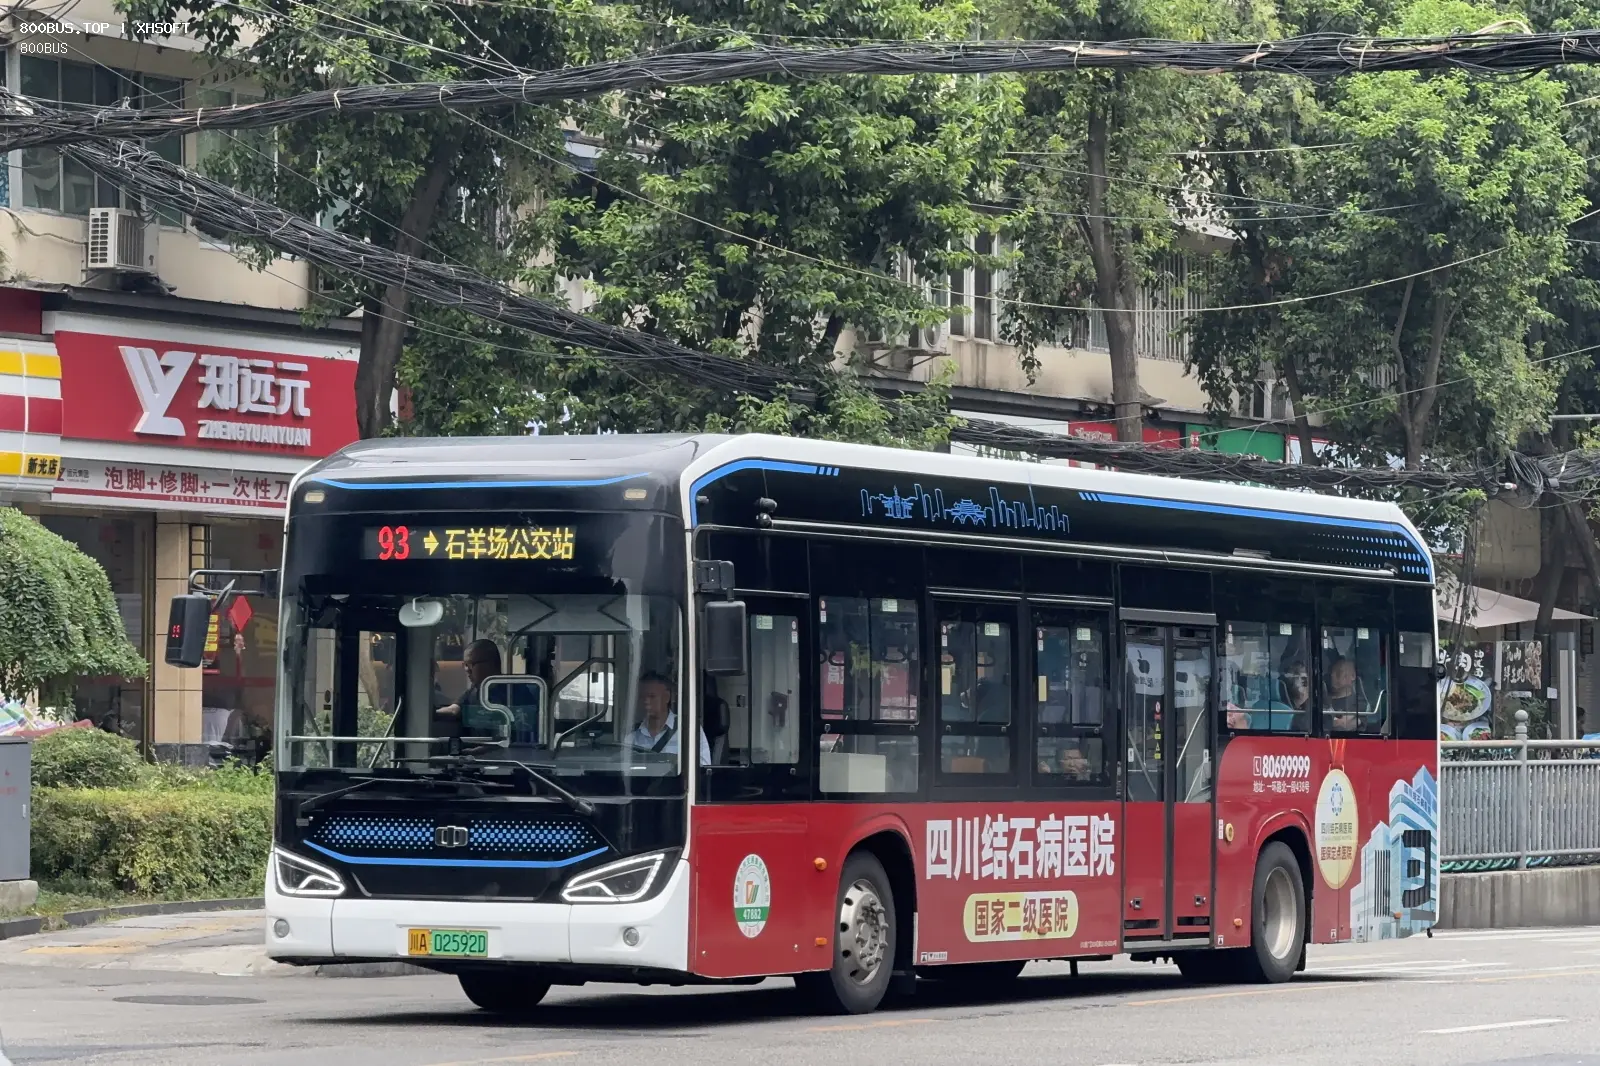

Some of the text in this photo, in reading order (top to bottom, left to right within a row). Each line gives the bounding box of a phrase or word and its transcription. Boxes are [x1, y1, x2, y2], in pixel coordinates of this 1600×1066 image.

[198, 354, 311, 417] 郑远元
[197, 420, 311, 446] ZHENGYUANYUAN
[27, 456, 58, 475] 新光店
[378, 525, 574, 560] 93 石羊场公交站
[1262, 754, 1310, 778] 80699999
[926, 812, 1115, 881] 四川结石病医院
[974, 896, 1069, 936] 国家二级医院
